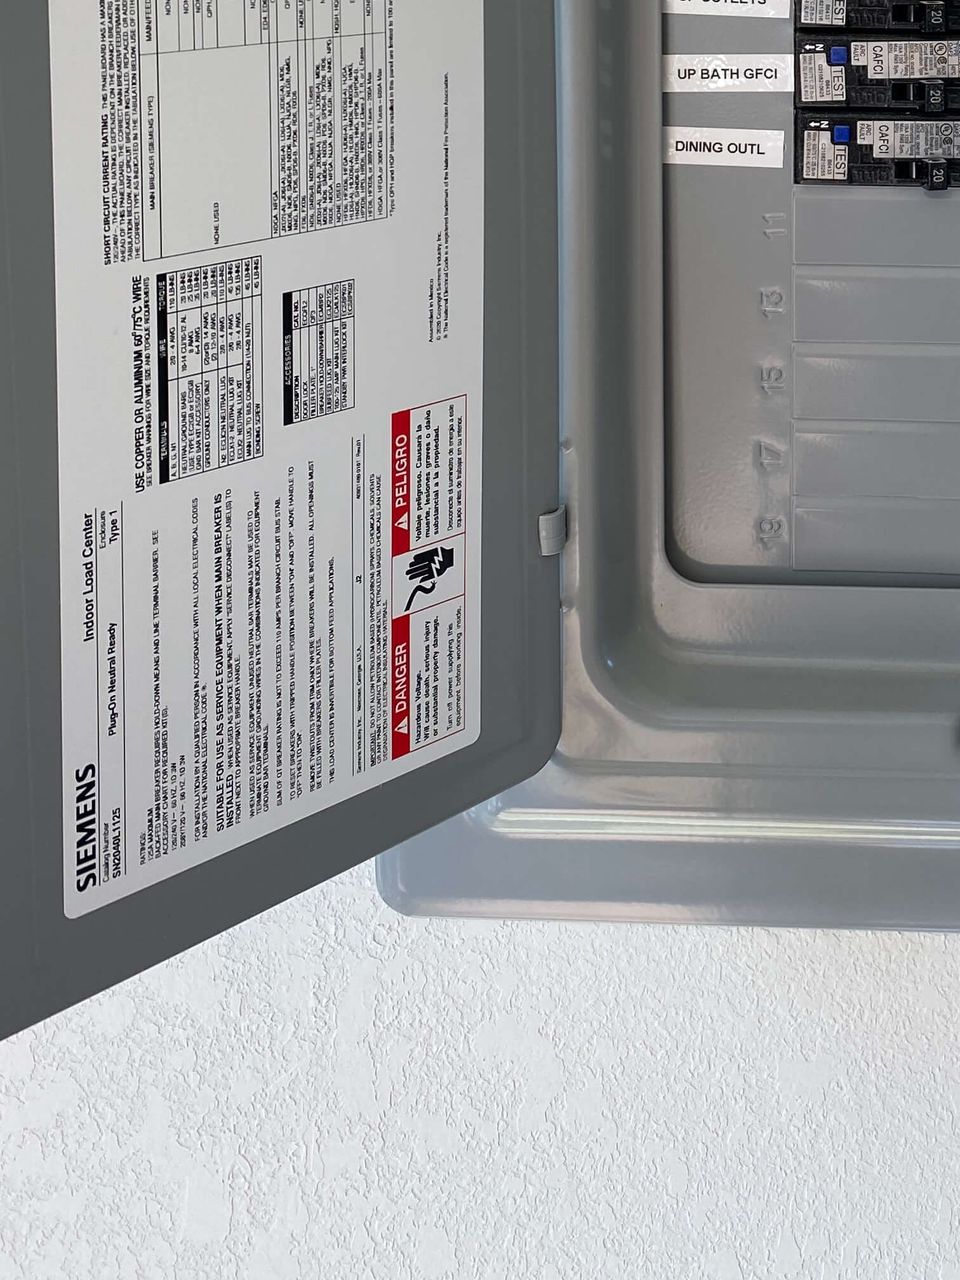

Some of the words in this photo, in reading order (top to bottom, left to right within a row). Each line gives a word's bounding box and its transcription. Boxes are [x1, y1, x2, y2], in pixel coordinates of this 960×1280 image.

[931, 11, 942, 24] 20
[678, 69, 696, 79] UP
[701, 69, 739, 79] BATH
[744, 68, 777, 79] GFCI
[873, 45, 883, 75] CAFCI
[833, 68, 844, 98] TEST
[931, 89, 941, 103] 20
[675, 141, 723, 152] DINING
[728, 143, 765, 154] OUTL
[879, 124, 889, 154] CAFCI
[836, 146, 846, 177] TEST
[933, 169, 944, 182] 20
[132, 274, 142, 301] WIRE
[134, 349, 144, 404] ALUMINUM
[134, 407, 144, 423] OR
[135, 425, 145, 469] COPPER
[135, 471, 145, 493] USE
[396, 433, 407, 508] PELIGRO
[214, 493, 222, 504] IS
[82, 512, 93, 558] Center
[109, 517, 119, 544] Type
[214, 505, 222, 553] BREAKER
[83, 560, 94, 594] Load
[215, 583, 223, 616] WHEN
[83, 597, 94, 642] Indoor
[107, 621, 117, 654] Ready
[216, 617, 224, 676] EQUIPMENT
[107, 655, 116, 693] Neutral
[395, 641, 407, 713] DANGER
[108, 694, 118, 736] Plug-On
[216, 722, 223, 736] AS
[75, 762, 96, 892] SIEMENS
[112, 806, 121, 878] SN2040L1125
